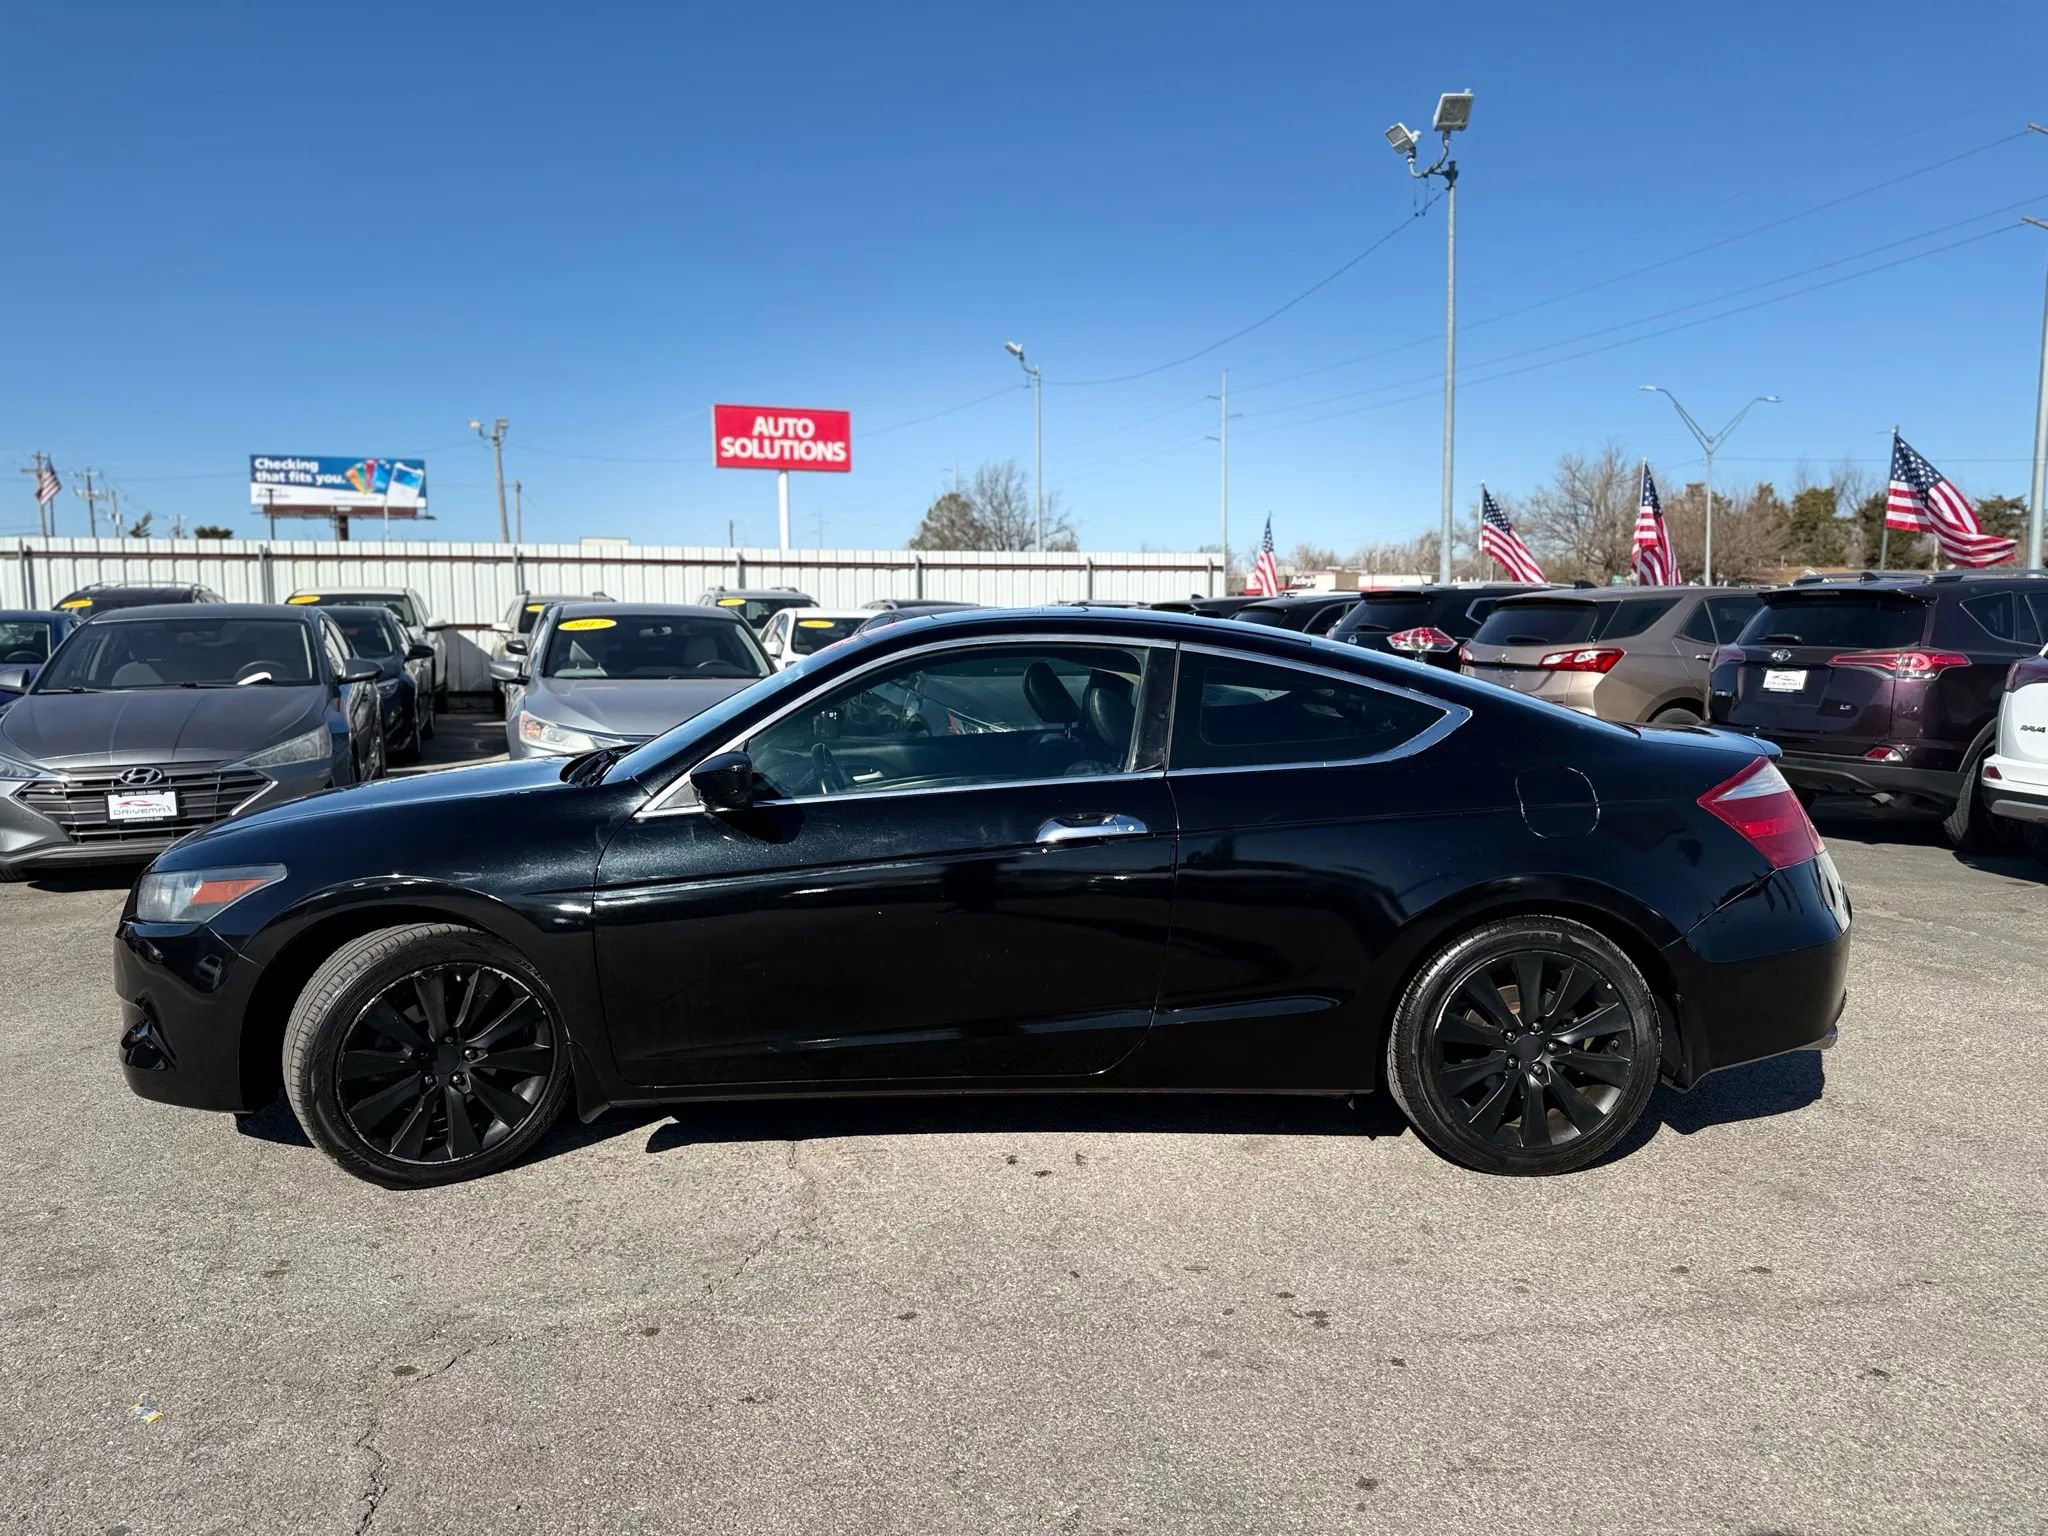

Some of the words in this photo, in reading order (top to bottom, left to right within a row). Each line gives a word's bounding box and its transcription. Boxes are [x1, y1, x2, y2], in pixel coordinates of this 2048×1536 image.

[752, 416, 815, 439] AUTO
[720, 436, 847, 462] SOLUTIONS
[254, 458, 319, 472] Checking
[255, 471, 287, 483] that
[289, 471, 312, 483] fits
[316, 474, 346, 486] you.
[2020, 725, 2046, 733] RAV4
[113, 805, 173, 816] DRIVEMAX
